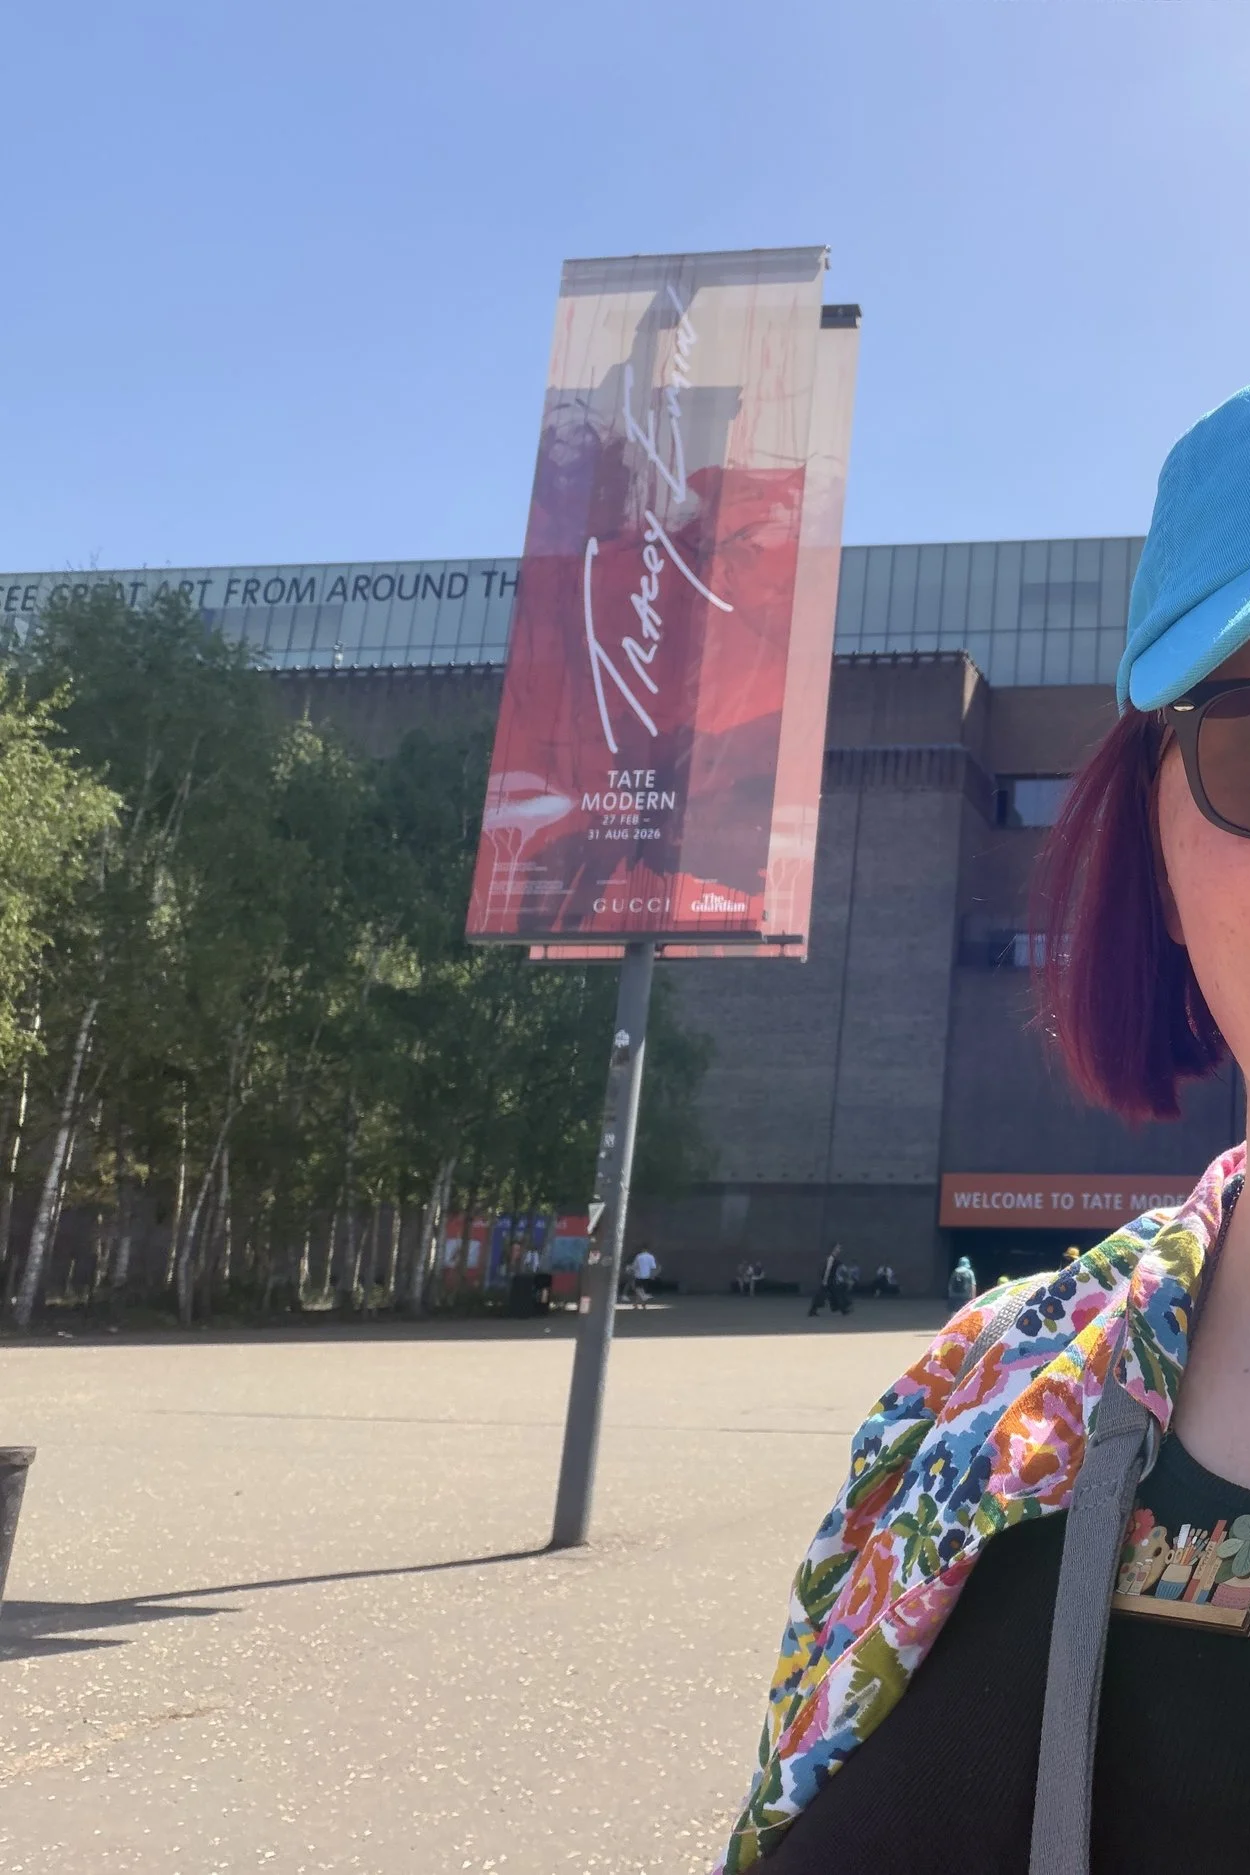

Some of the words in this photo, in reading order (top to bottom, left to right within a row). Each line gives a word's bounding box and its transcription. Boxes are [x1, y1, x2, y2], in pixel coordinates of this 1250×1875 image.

[47, 580, 147, 611] GRAT
[223, 575, 316, 605] FROM
[325, 571, 469, 602] AROUND
[480, 569, 519, 598] TH
[607, 769, 656, 789] TATE
[580, 790, 676, 811] MODERN
[602, 814, 617, 826] 27
[620, 813, 640, 826] FEB
[587, 828, 600, 841] 31
[604, 828, 629, 841] AUG
[633, 827, 661, 841] 2026
[593, 896, 671, 914] GUCCI
[953, 1191, 1044, 1210] WELCOME
[1051, 1192, 1075, 1211] TO
[1081, 1192, 1123, 1211] TATE
[1130, 1193, 1186, 1211] MODE
